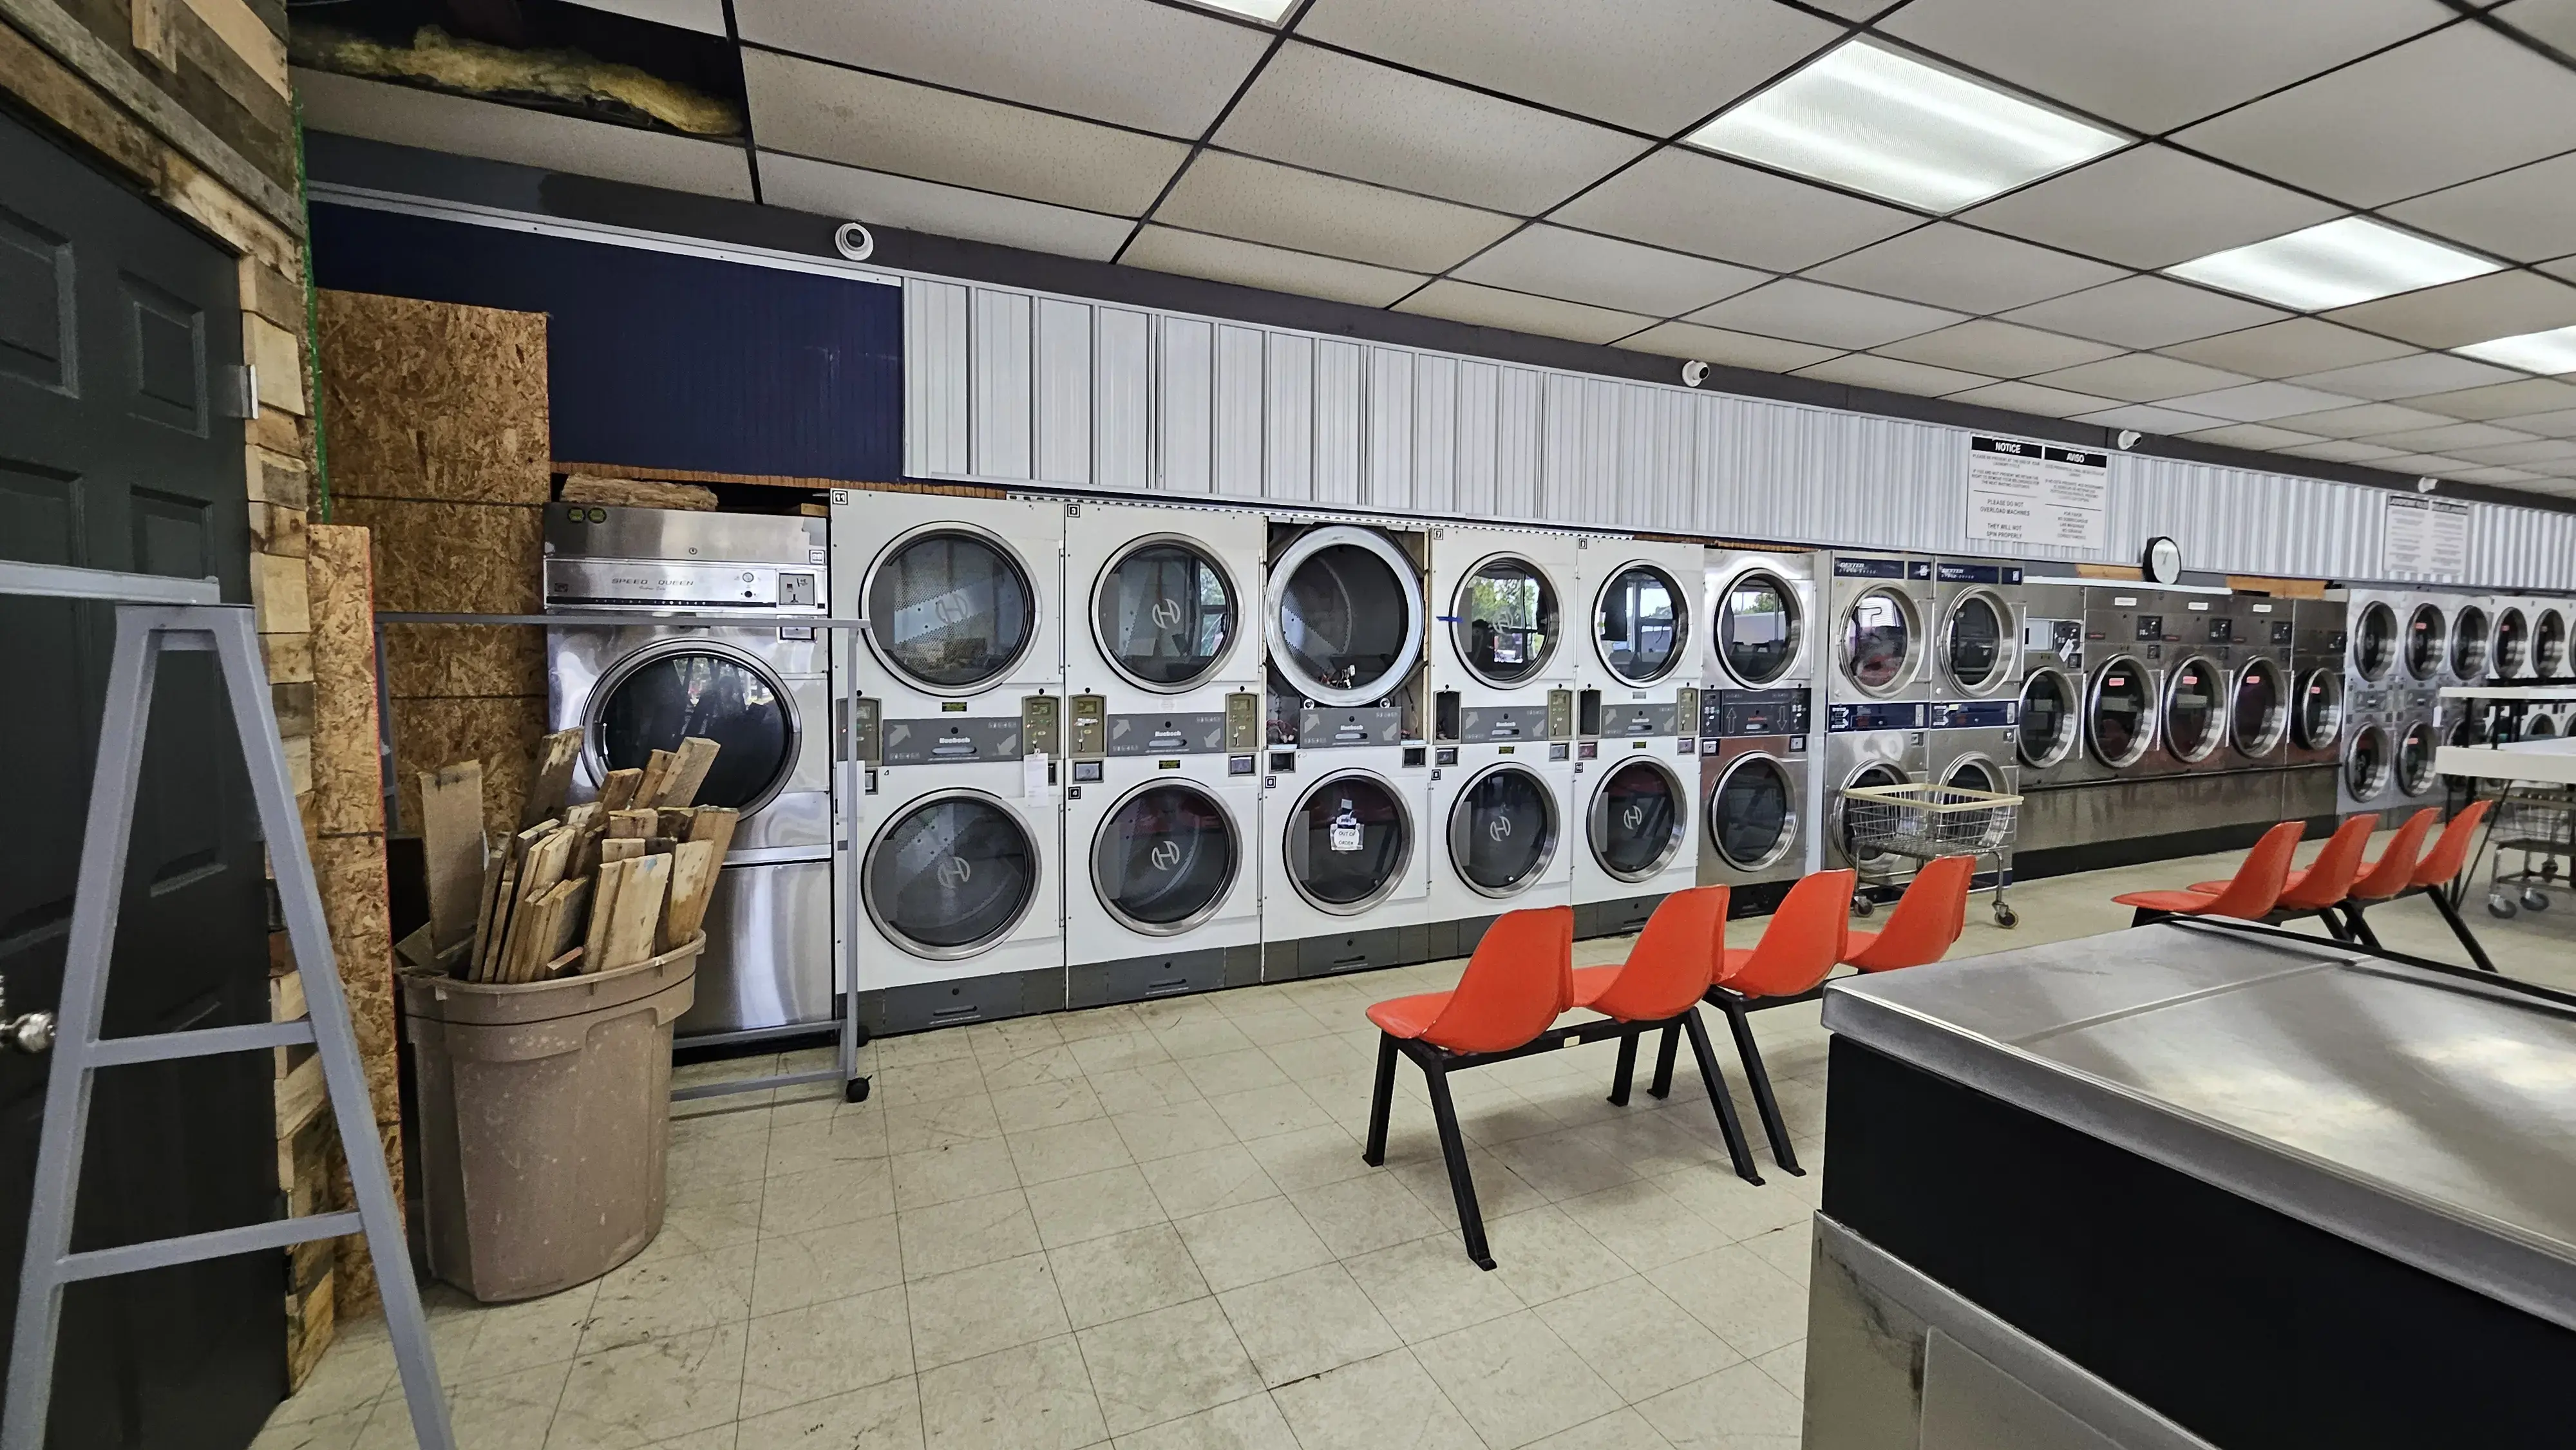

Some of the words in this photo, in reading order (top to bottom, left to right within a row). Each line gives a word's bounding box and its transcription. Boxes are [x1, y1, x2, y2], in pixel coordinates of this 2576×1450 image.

[1995, 442, 2021, 453] NOTICE
[2066, 453, 2085, 463] AVISO
[1980, 505, 2006, 514] OVERLOAD
